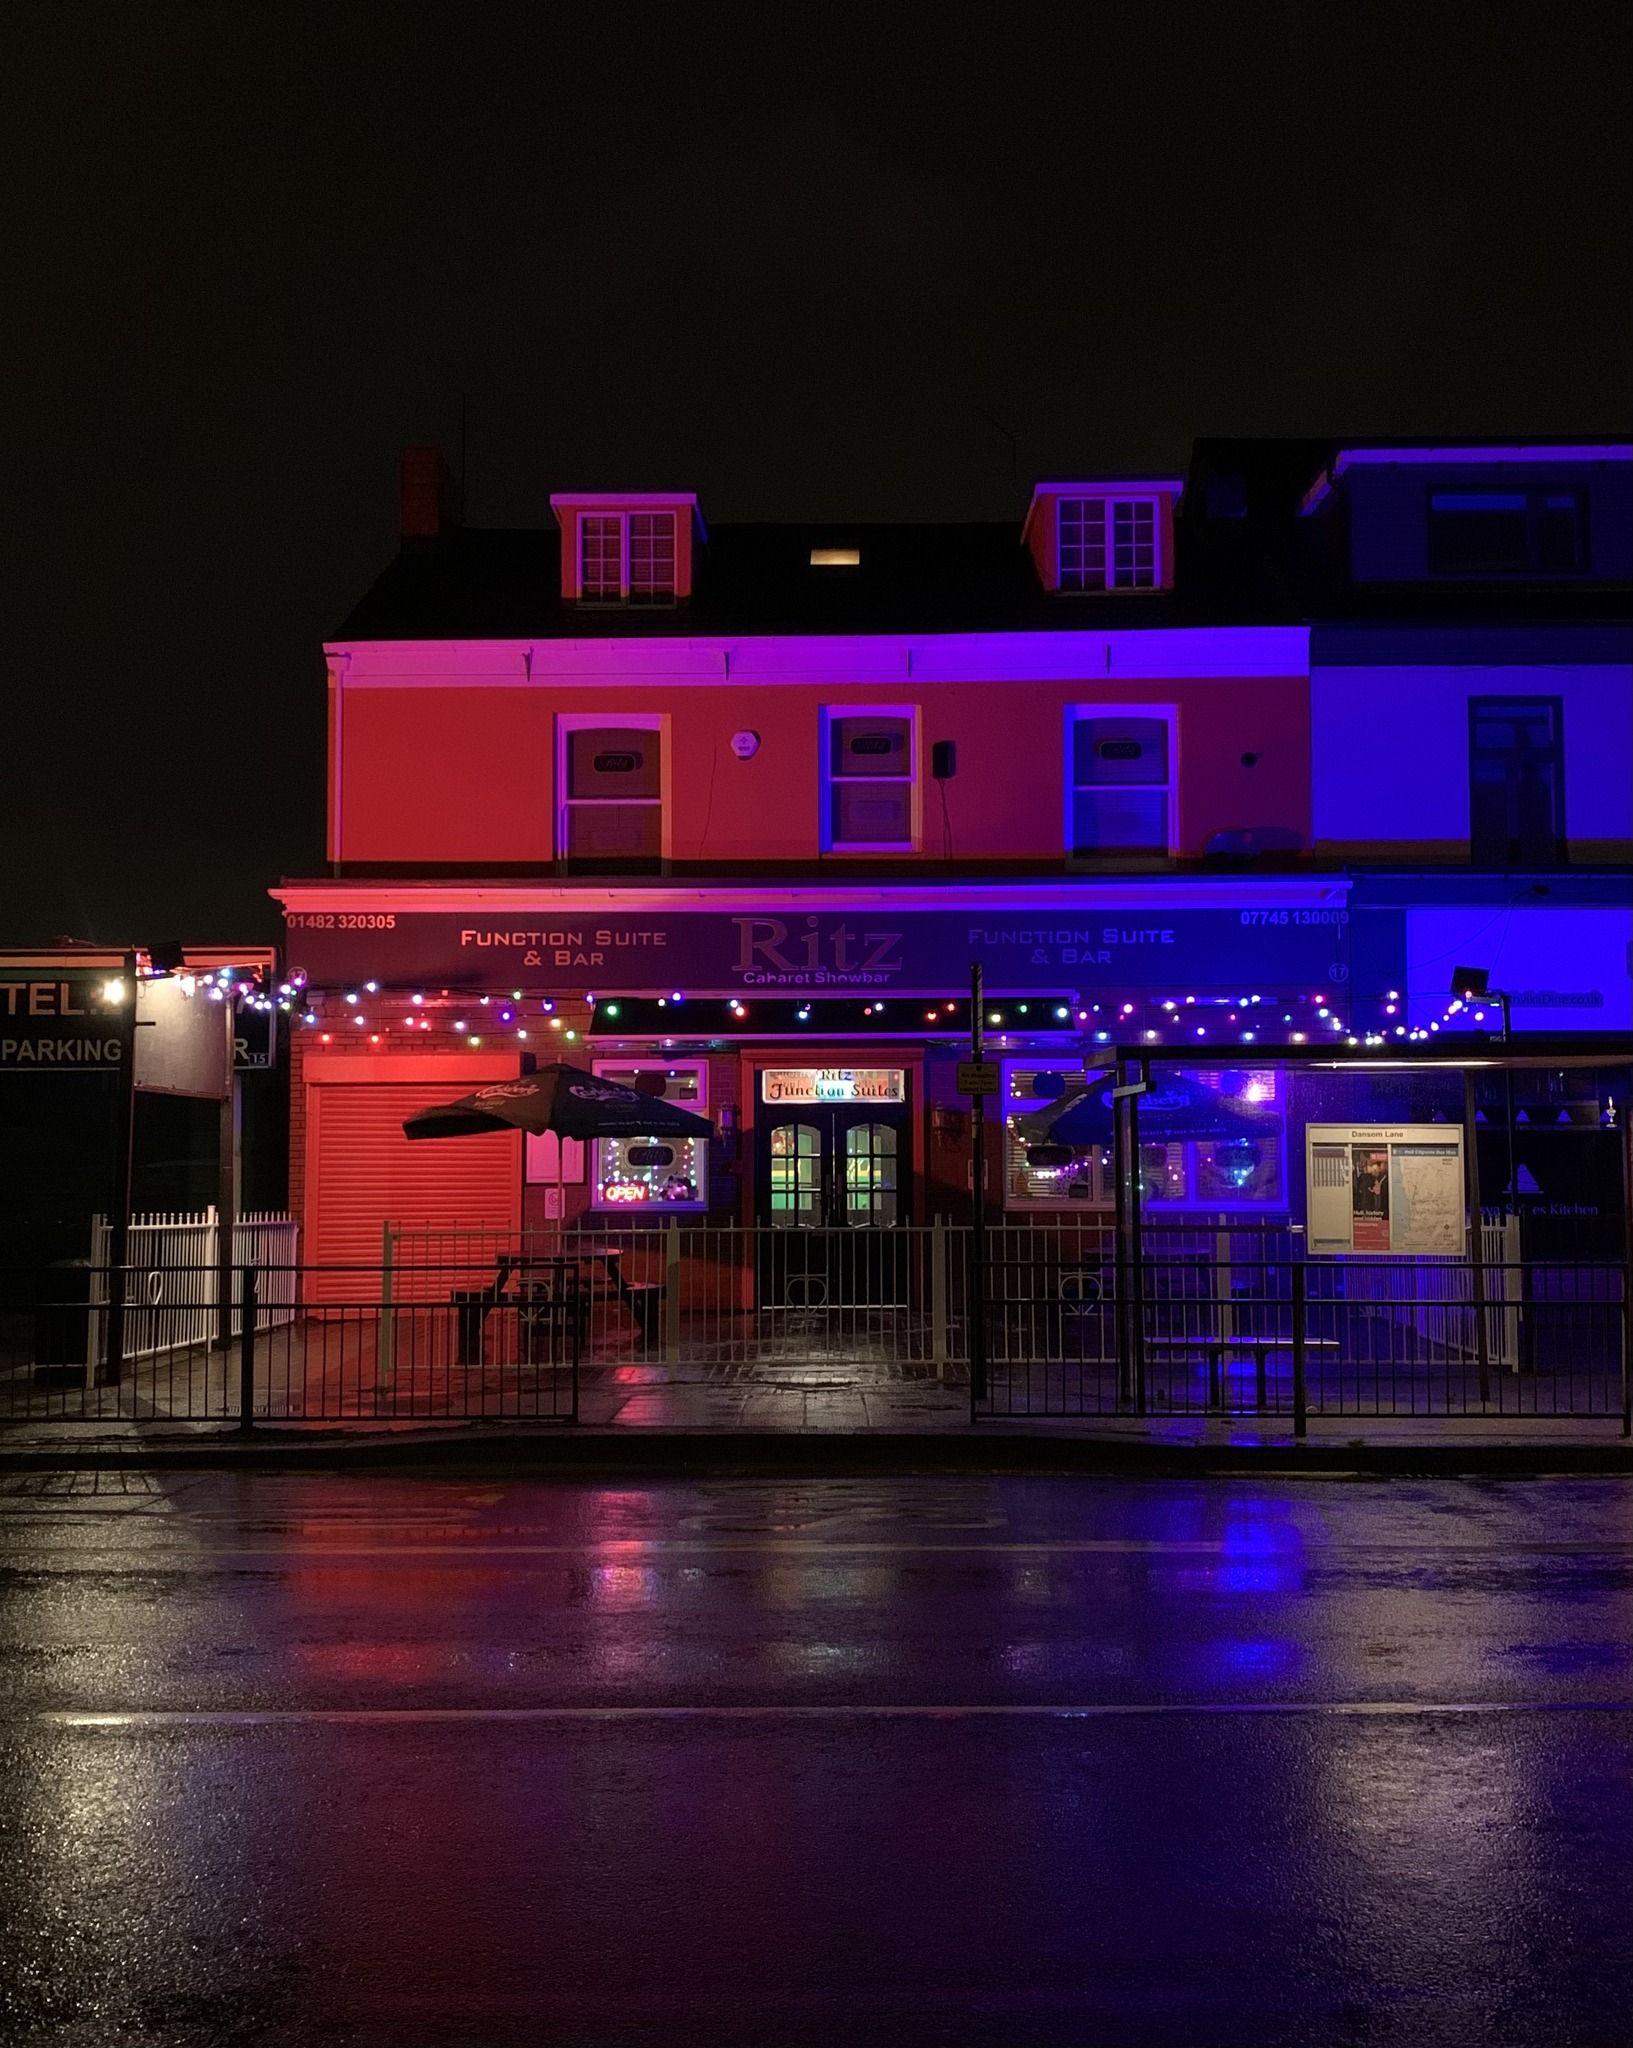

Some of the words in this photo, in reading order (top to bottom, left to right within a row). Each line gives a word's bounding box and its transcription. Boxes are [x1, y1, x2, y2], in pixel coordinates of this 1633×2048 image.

[287, 914, 335, 929] 01482
[338, 914, 396, 929] 320305
[1241, 910, 1289, 925] 07745
[1292, 910, 1350, 925] 130009
[731, 915, 903, 972] Ritz
[523, 950, 542, 966] &
[1031, 949, 1050, 964] &
[743, 972, 810, 984] Cabaret
[814, 972, 891, 984] Showbar
[1331, 966, 1346, 978] 17
[2, 1039, 122, 1061] PARKING
[252, 1053, 267, 1065] 15
[769, 1083, 845, 1100] Function
[851, 1084, 898, 1097] Suites
[1351, 1130, 1383, 1138] Dansom
[1384, 1130, 1404, 1138] Lane
[605, 1185, 646, 1201] OPEN
[1550, 1203, 1599, 1216] Kitchen
